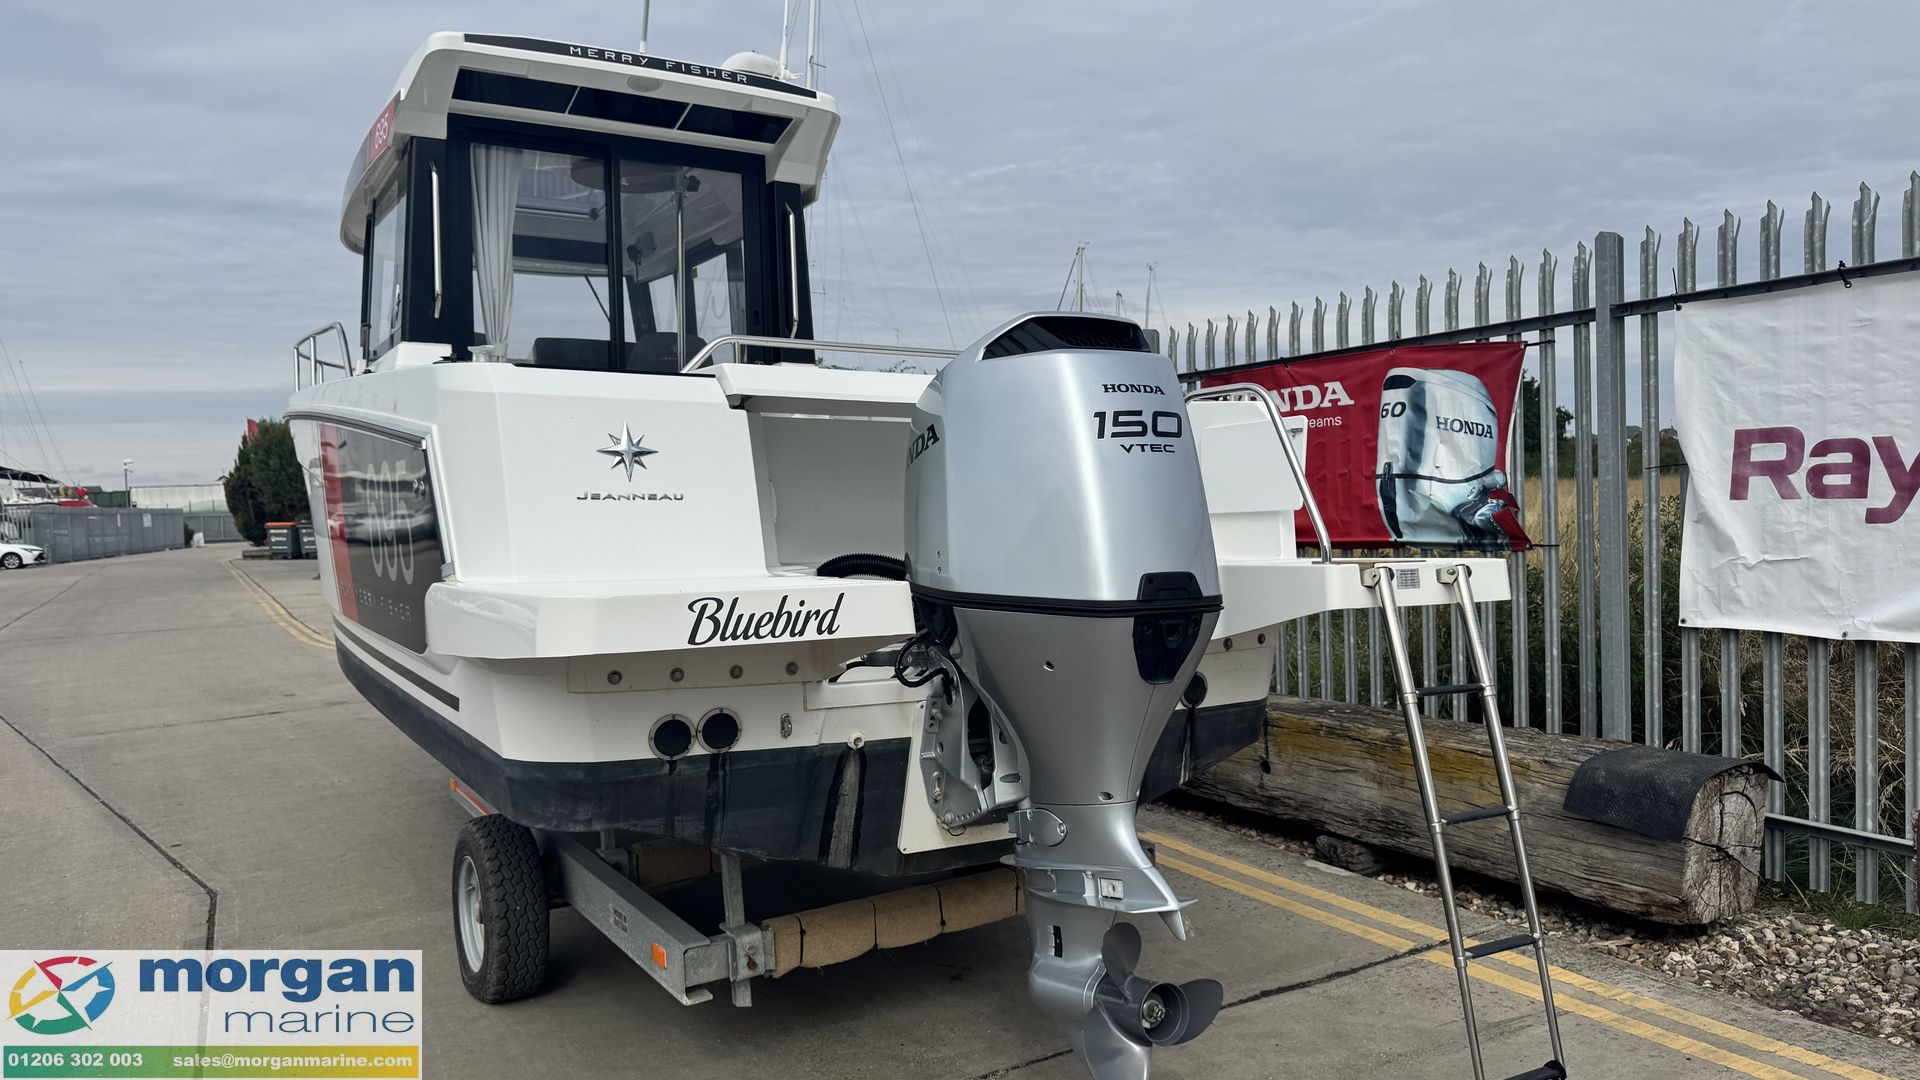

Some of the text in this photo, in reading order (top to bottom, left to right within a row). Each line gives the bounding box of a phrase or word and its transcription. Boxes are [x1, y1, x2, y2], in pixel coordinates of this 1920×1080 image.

[569, 46, 748, 84] MERRY FISHER
[1101, 383, 1166, 396] HONDA
[1269, 381, 1355, 413] NDA
[1307, 416, 1343, 429] eams
[1380, 401, 1407, 419] 60
[1092, 409, 1183, 440] 150
[1435, 415, 1494, 440] HONDA
[906, 423, 940, 469] NDA
[1119, 443, 1176, 454] VTEC
[1729, 426, 1920, 524] Ray
[576, 491, 684, 501] JEANNEAU
[686, 592, 845, 646] Bluebird
